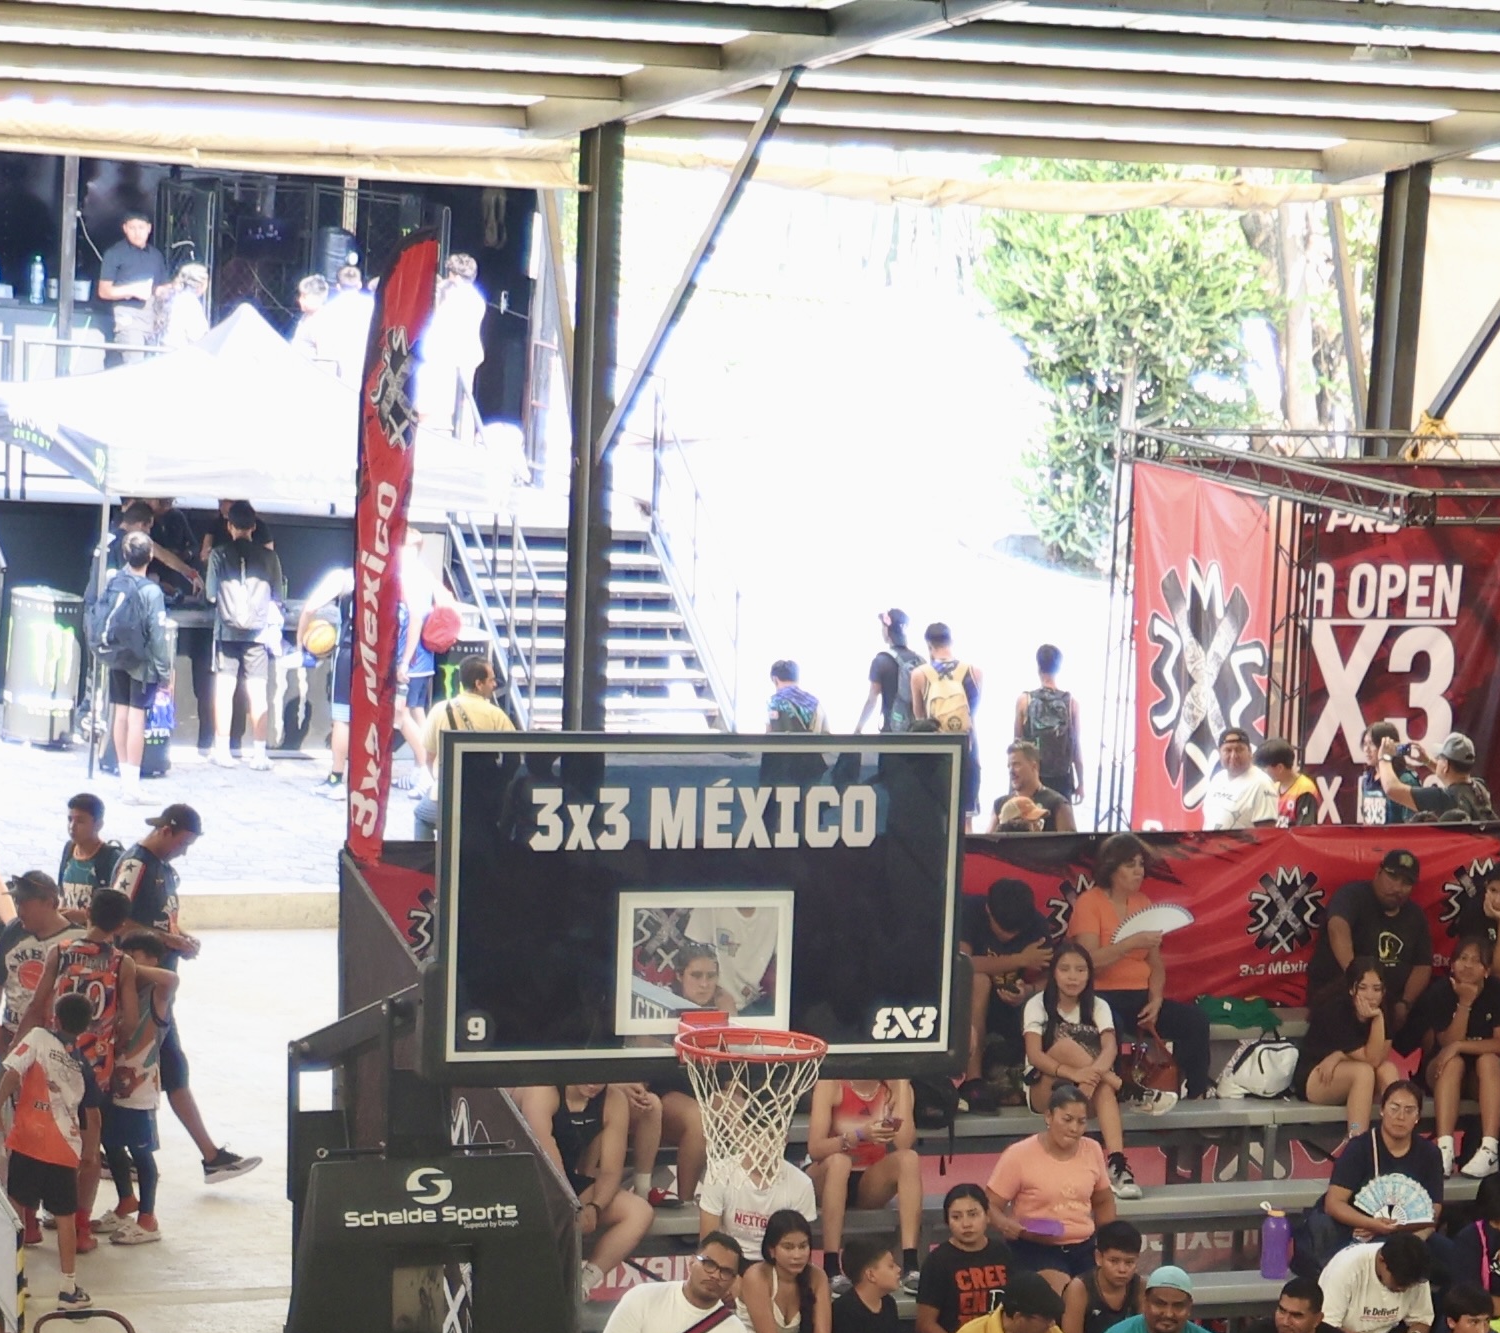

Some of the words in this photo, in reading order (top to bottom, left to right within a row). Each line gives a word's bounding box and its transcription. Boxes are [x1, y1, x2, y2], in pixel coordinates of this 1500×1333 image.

[1347, 562, 1463, 618] OPEN
[529, 787, 631, 852] 3x3
[650, 778, 878, 849] MÉXICO
[466, 1016, 487, 1042] 9
[344, 1207, 438, 1229] Schelde
[441, 1203, 519, 1227] Sports
